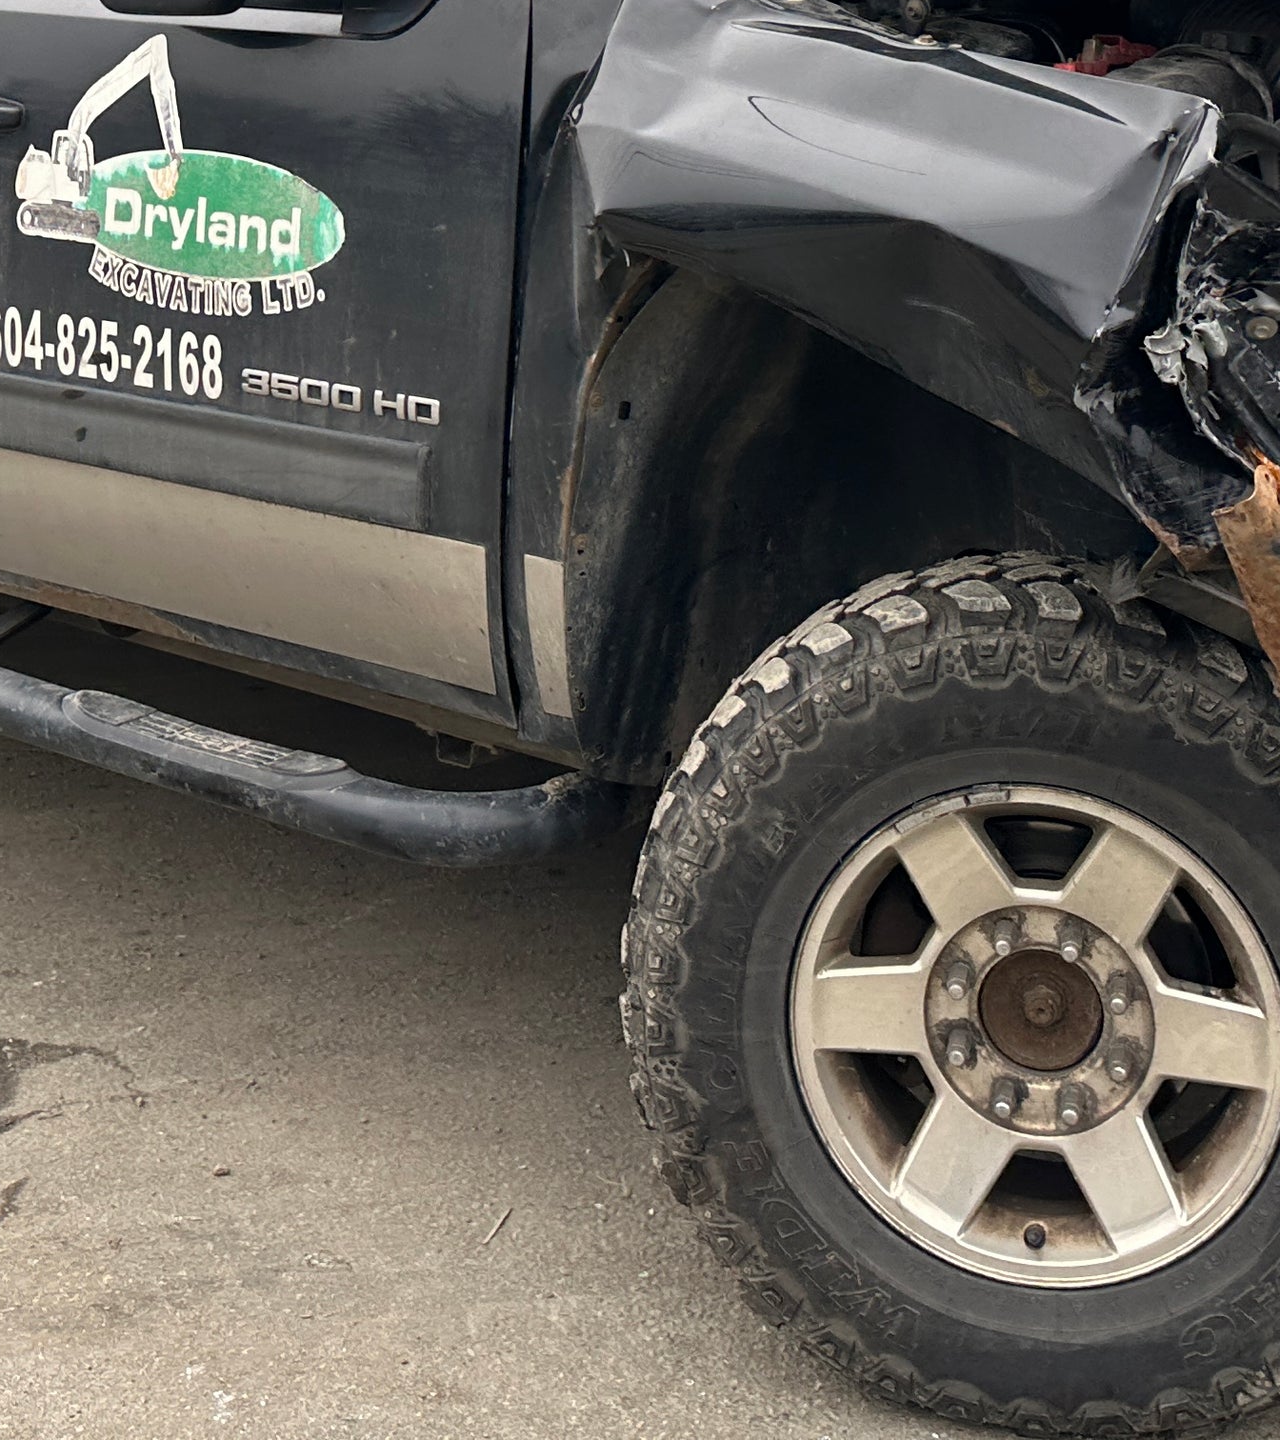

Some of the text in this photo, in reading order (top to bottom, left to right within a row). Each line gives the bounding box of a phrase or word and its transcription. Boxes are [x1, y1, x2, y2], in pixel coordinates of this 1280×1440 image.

[103, 186, 302, 255] Dryland
[88, 245, 326, 317] EXCAVATING LTD.
[241, 368, 441, 426] 3500 HD
